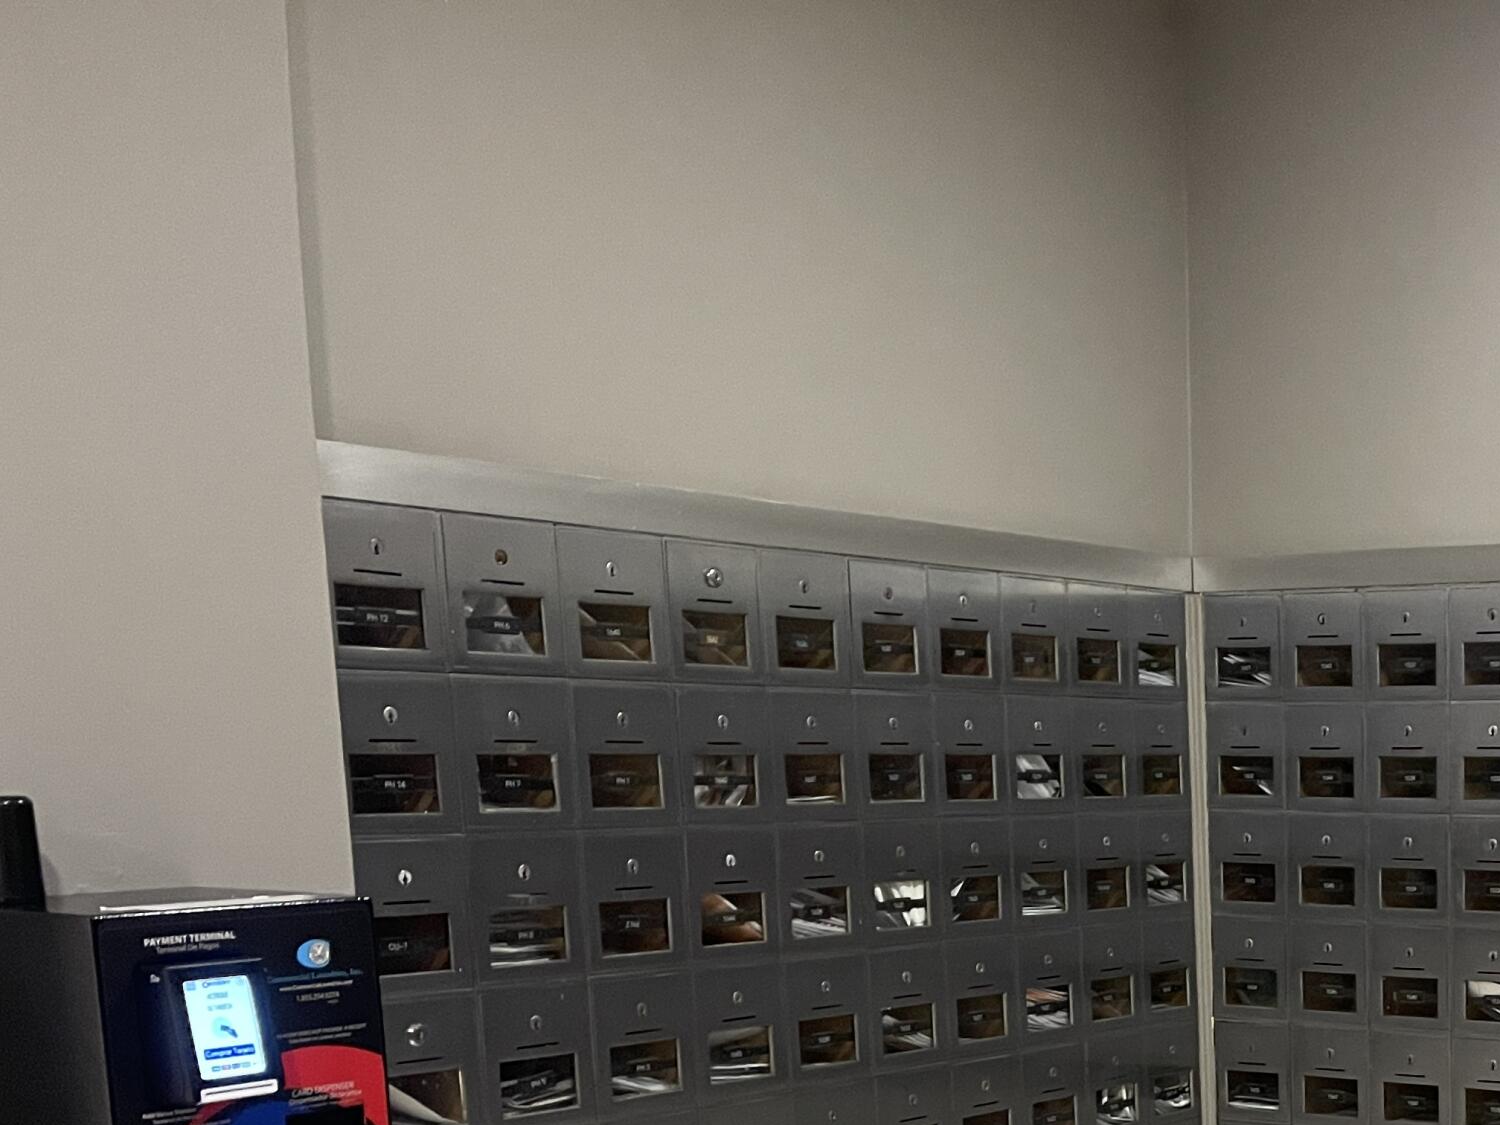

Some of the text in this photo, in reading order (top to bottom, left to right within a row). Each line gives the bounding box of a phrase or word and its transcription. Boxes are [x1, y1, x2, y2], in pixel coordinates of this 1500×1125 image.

[143, 930, 237, 947] PAYMENT TERMINAL
[291, 1086, 314, 1098] CARD
[314, 1080, 355, 1094] DISPENSER
